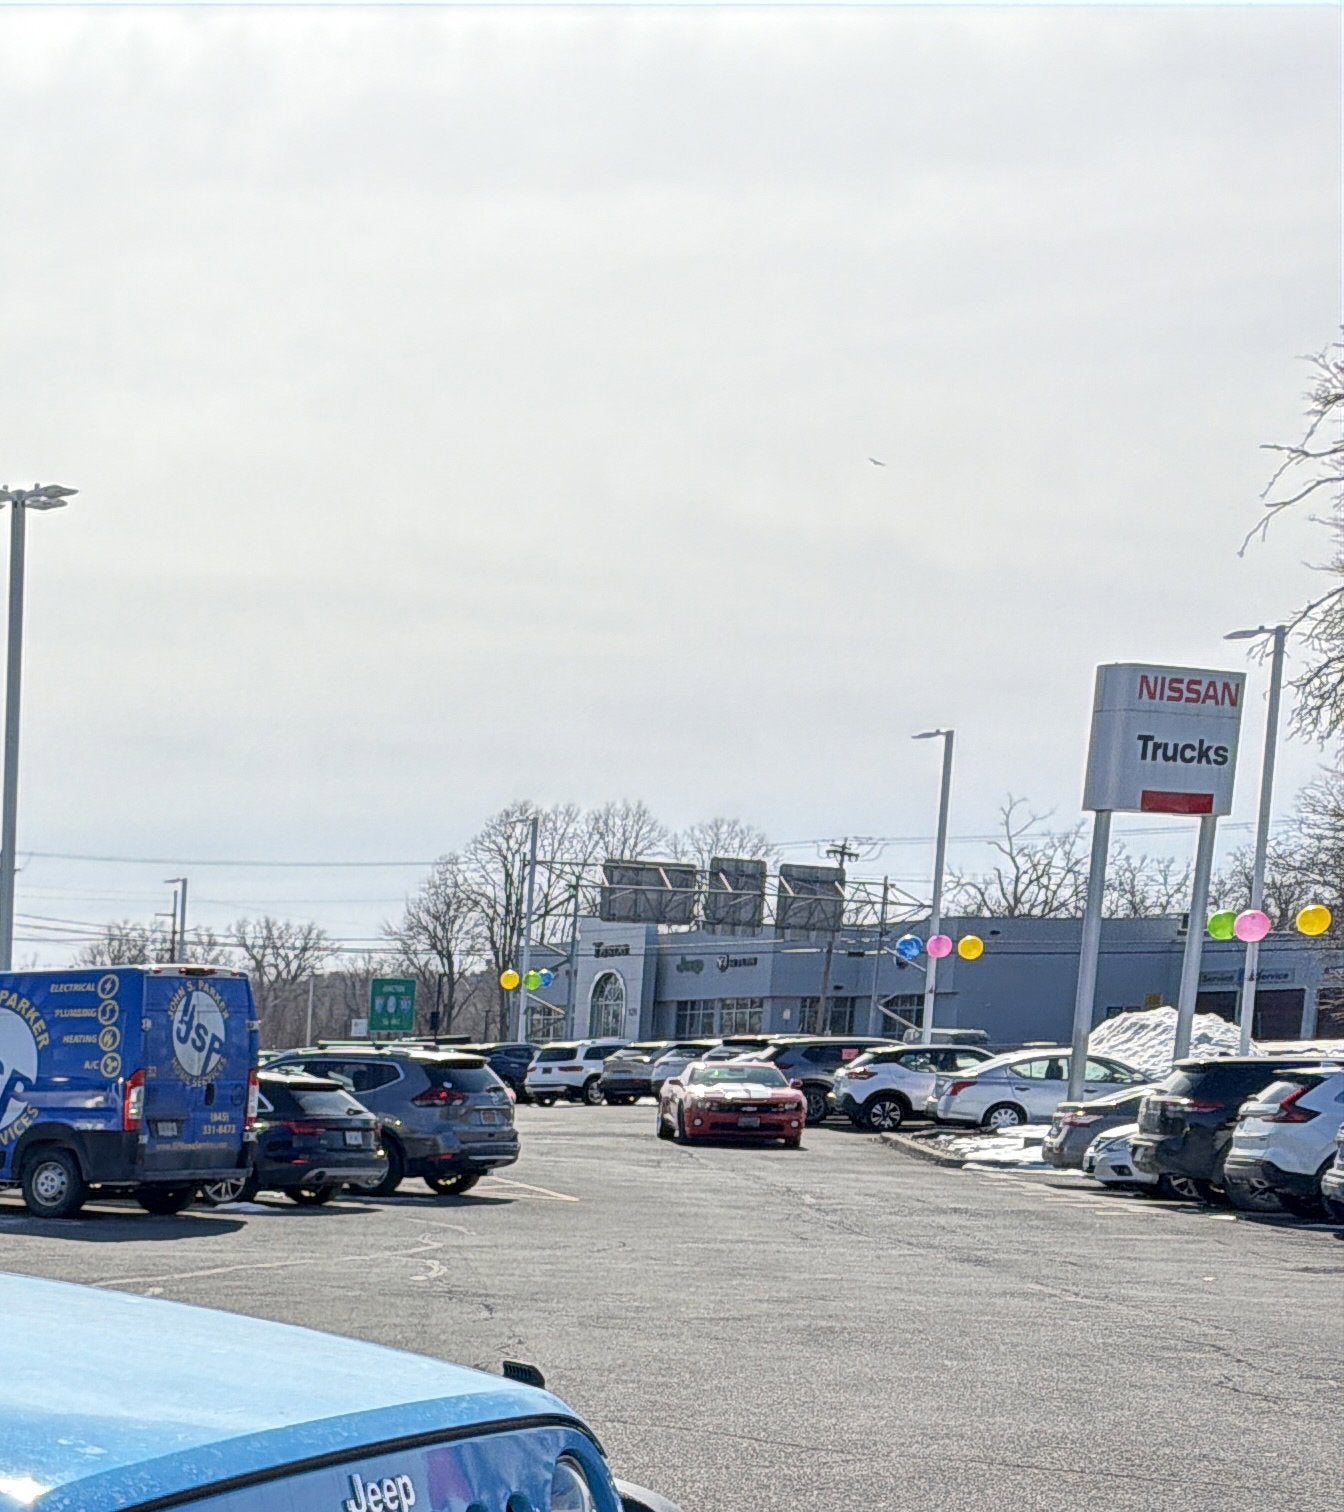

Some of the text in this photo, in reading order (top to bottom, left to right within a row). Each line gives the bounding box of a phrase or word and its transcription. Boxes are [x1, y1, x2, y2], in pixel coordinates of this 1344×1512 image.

[1139, 675, 1240, 707] NISSAN
[1137, 735, 1229, 766] Trucks
[50, 983, 96, 993] ELECTRICAL
[55, 1008, 97, 1018] PLUMBING
[63, 1034, 98, 1044] HEATING
[84, 1060, 99, 1070] A/C
